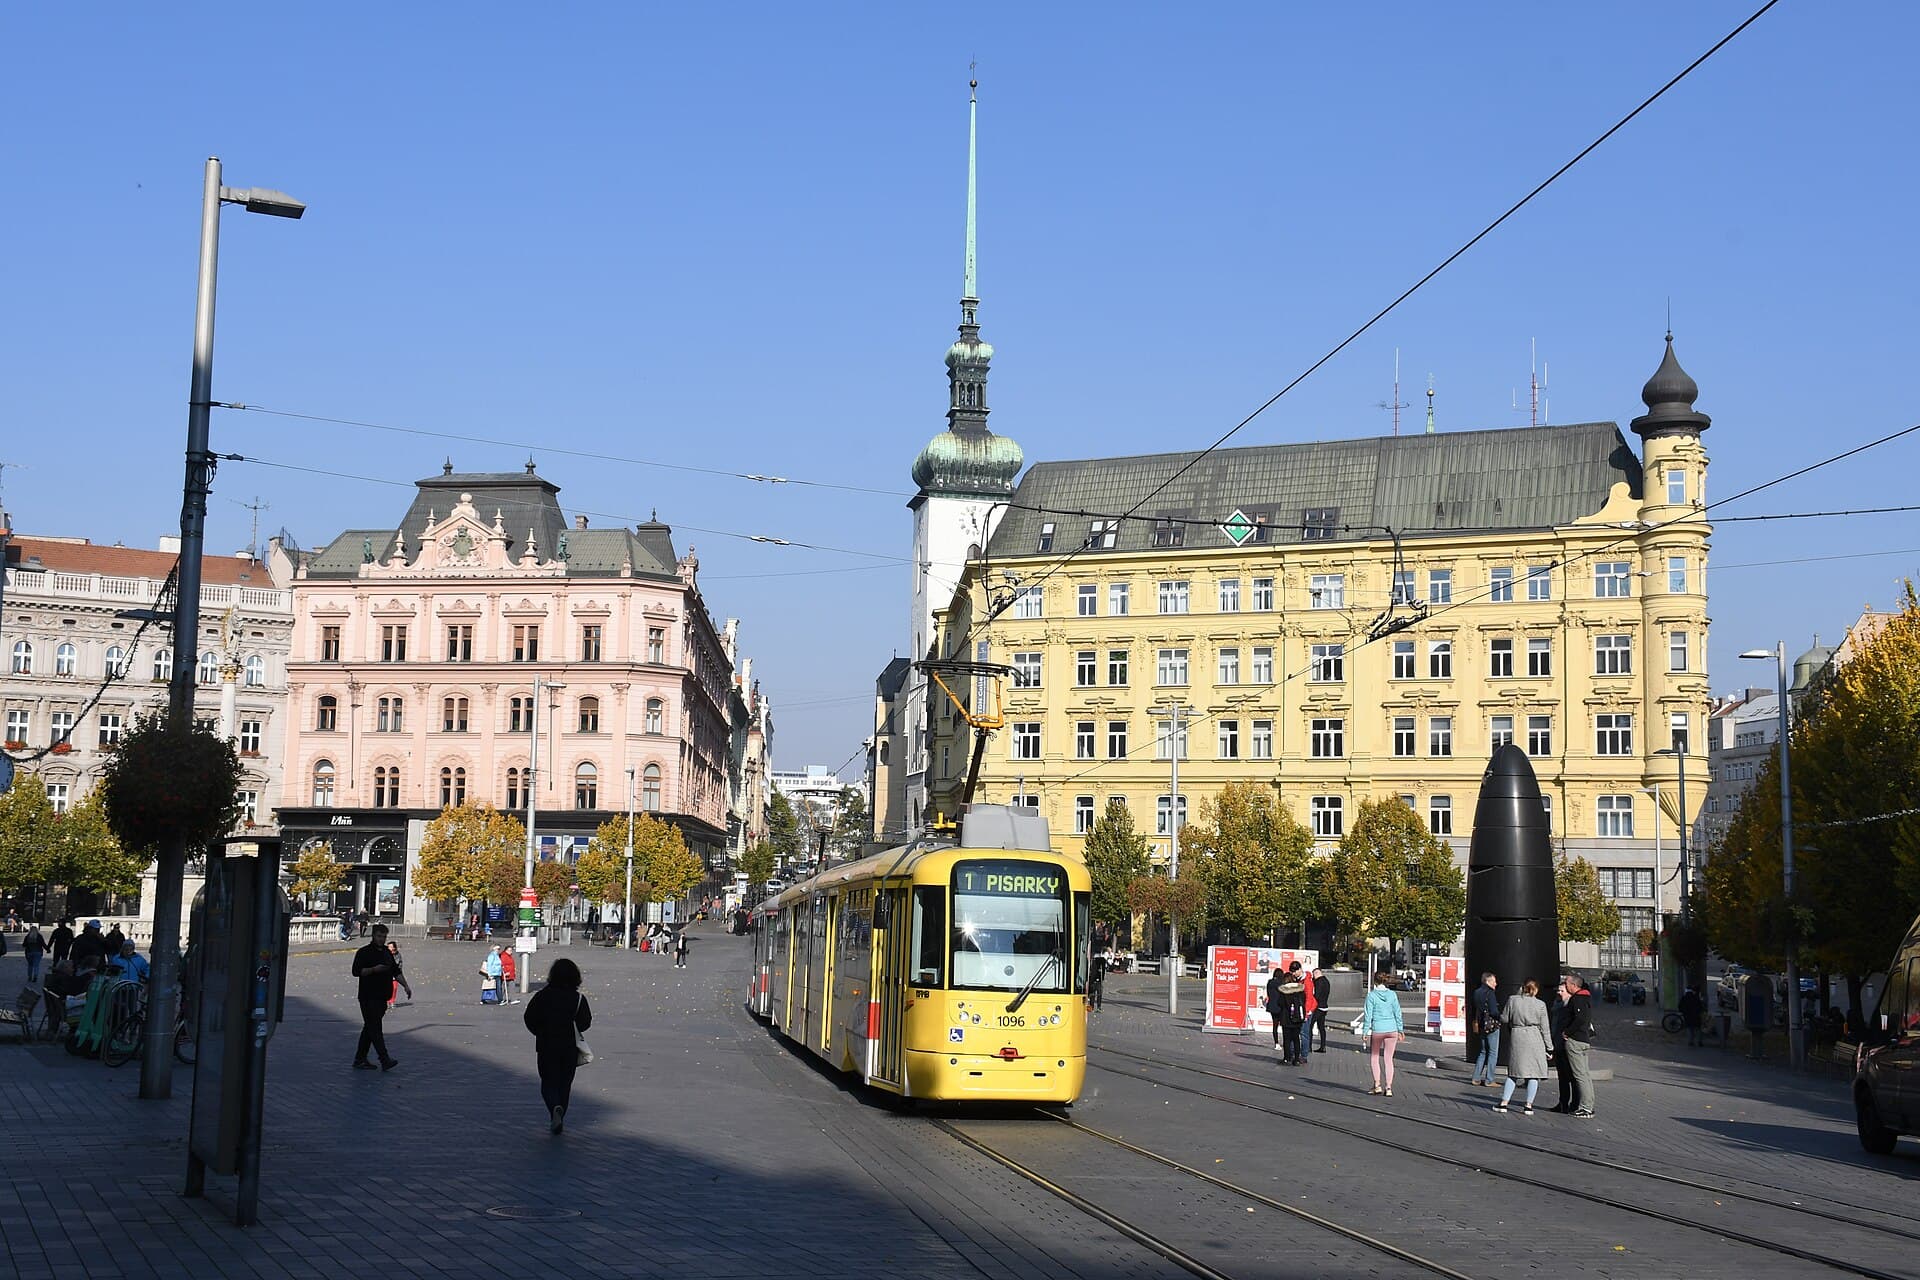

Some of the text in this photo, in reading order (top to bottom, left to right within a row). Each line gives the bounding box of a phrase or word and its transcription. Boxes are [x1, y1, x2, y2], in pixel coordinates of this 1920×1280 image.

[965, 872, 1059, 894] 1 PISARKY
[997, 1015, 1025, 1027] 1096
